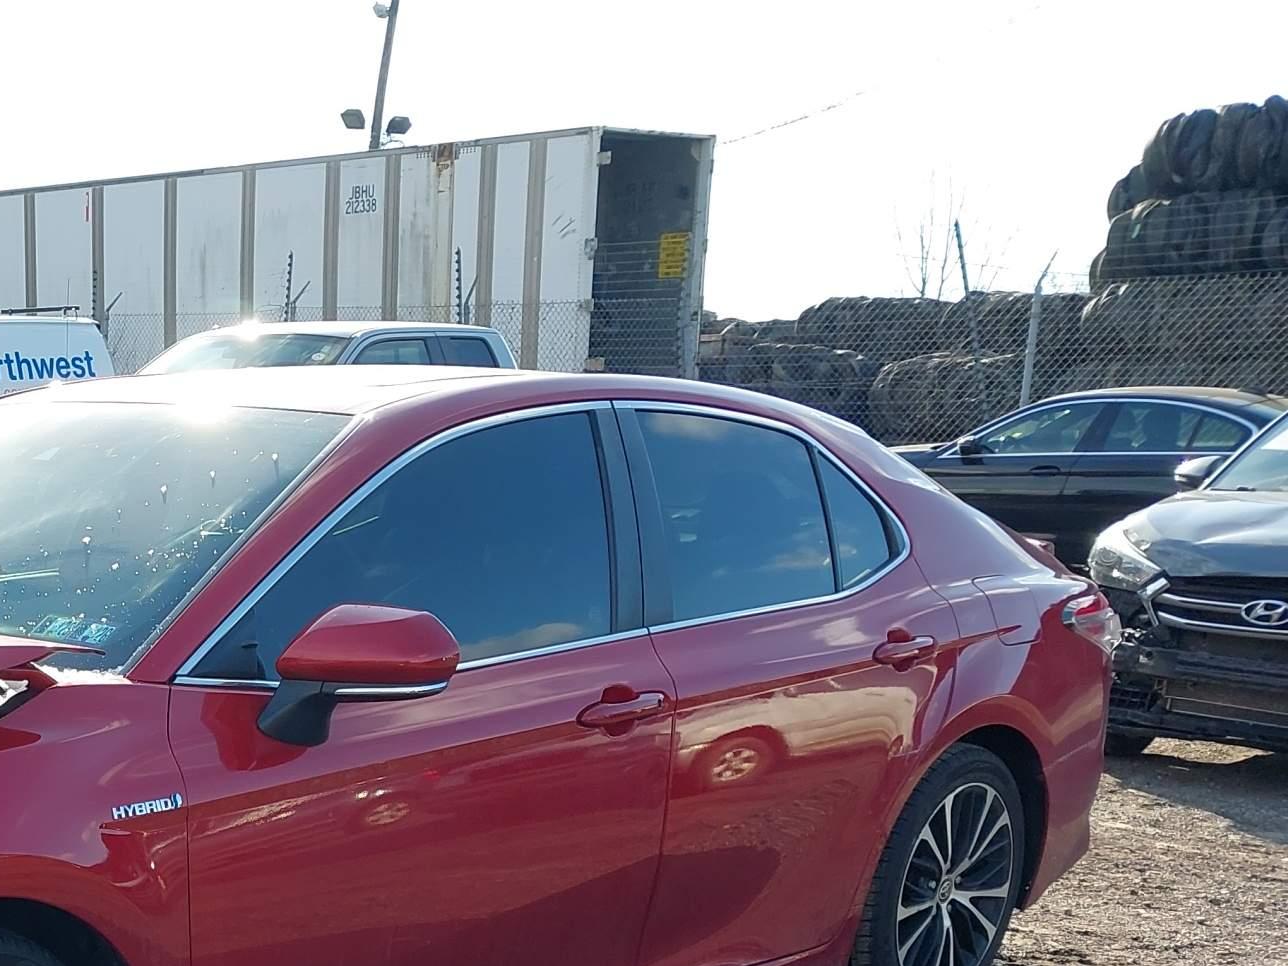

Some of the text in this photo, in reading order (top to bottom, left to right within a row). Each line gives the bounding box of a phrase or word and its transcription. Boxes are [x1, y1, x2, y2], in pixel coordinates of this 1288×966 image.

[348, 184, 375, 200] JBHU
[345, 198, 377, 215] 212338
[112, 797, 174, 820] HYBRID
